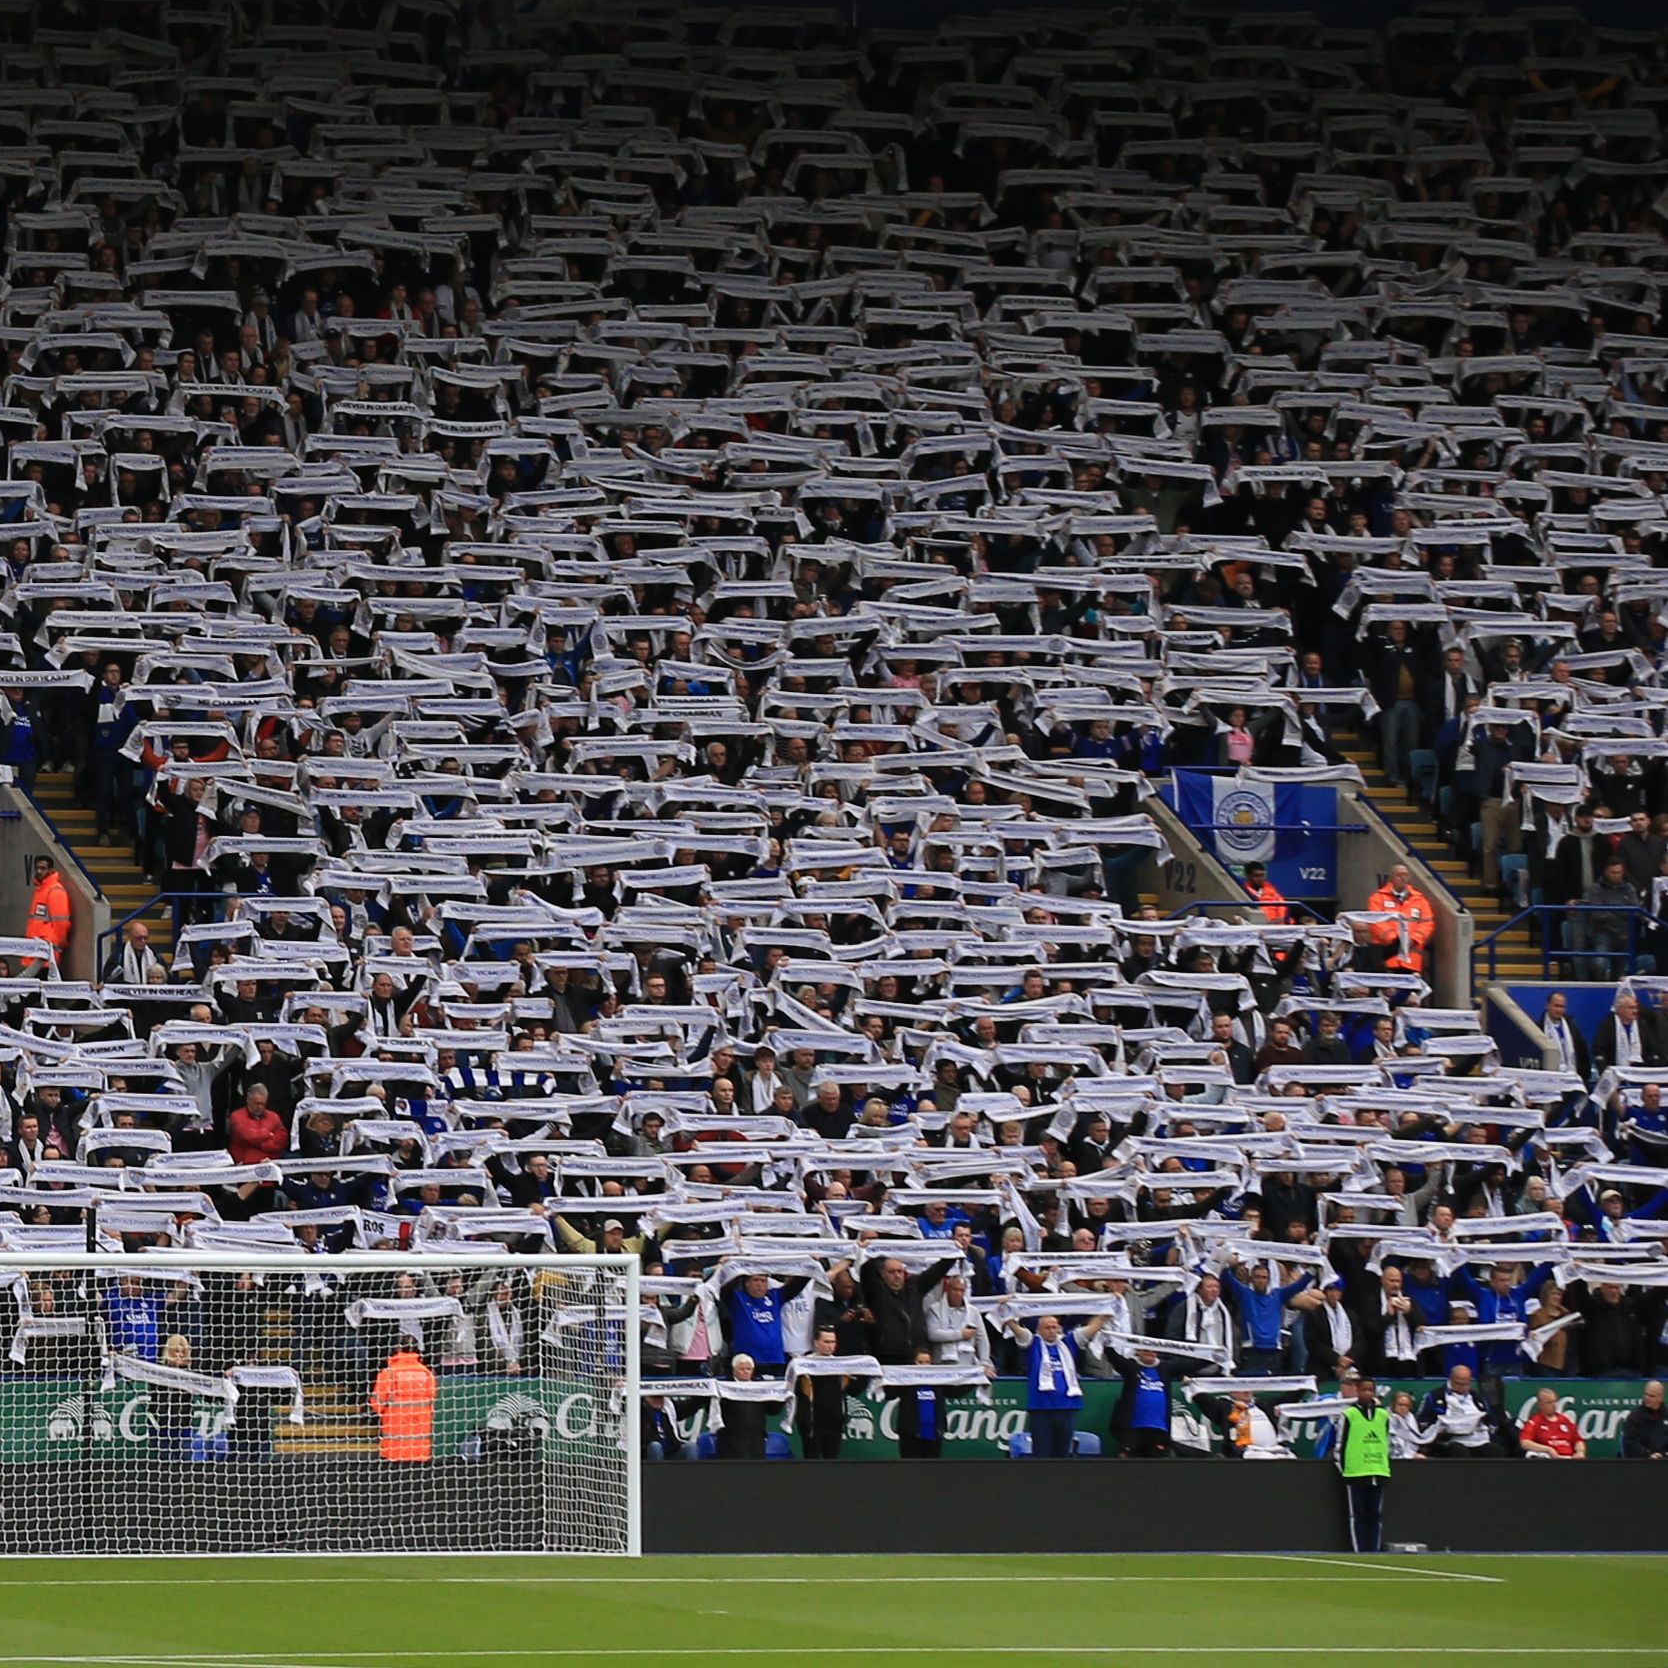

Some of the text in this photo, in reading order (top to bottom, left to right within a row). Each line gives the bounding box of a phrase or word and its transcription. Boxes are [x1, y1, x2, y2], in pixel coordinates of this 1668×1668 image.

[25, 675, 39, 683] OUR
[40, 675, 71, 683] HEARTS
[212, 698, 261, 706] CHAIRMAN
[1164, 861, 1196, 894] V22
[1298, 867, 1327, 881] V22
[655, 1383, 700, 1391] CHAIRMAN
[1581, 1398, 1644, 1407] LAGER BEE
[878, 1396, 1027, 1451] Cang
